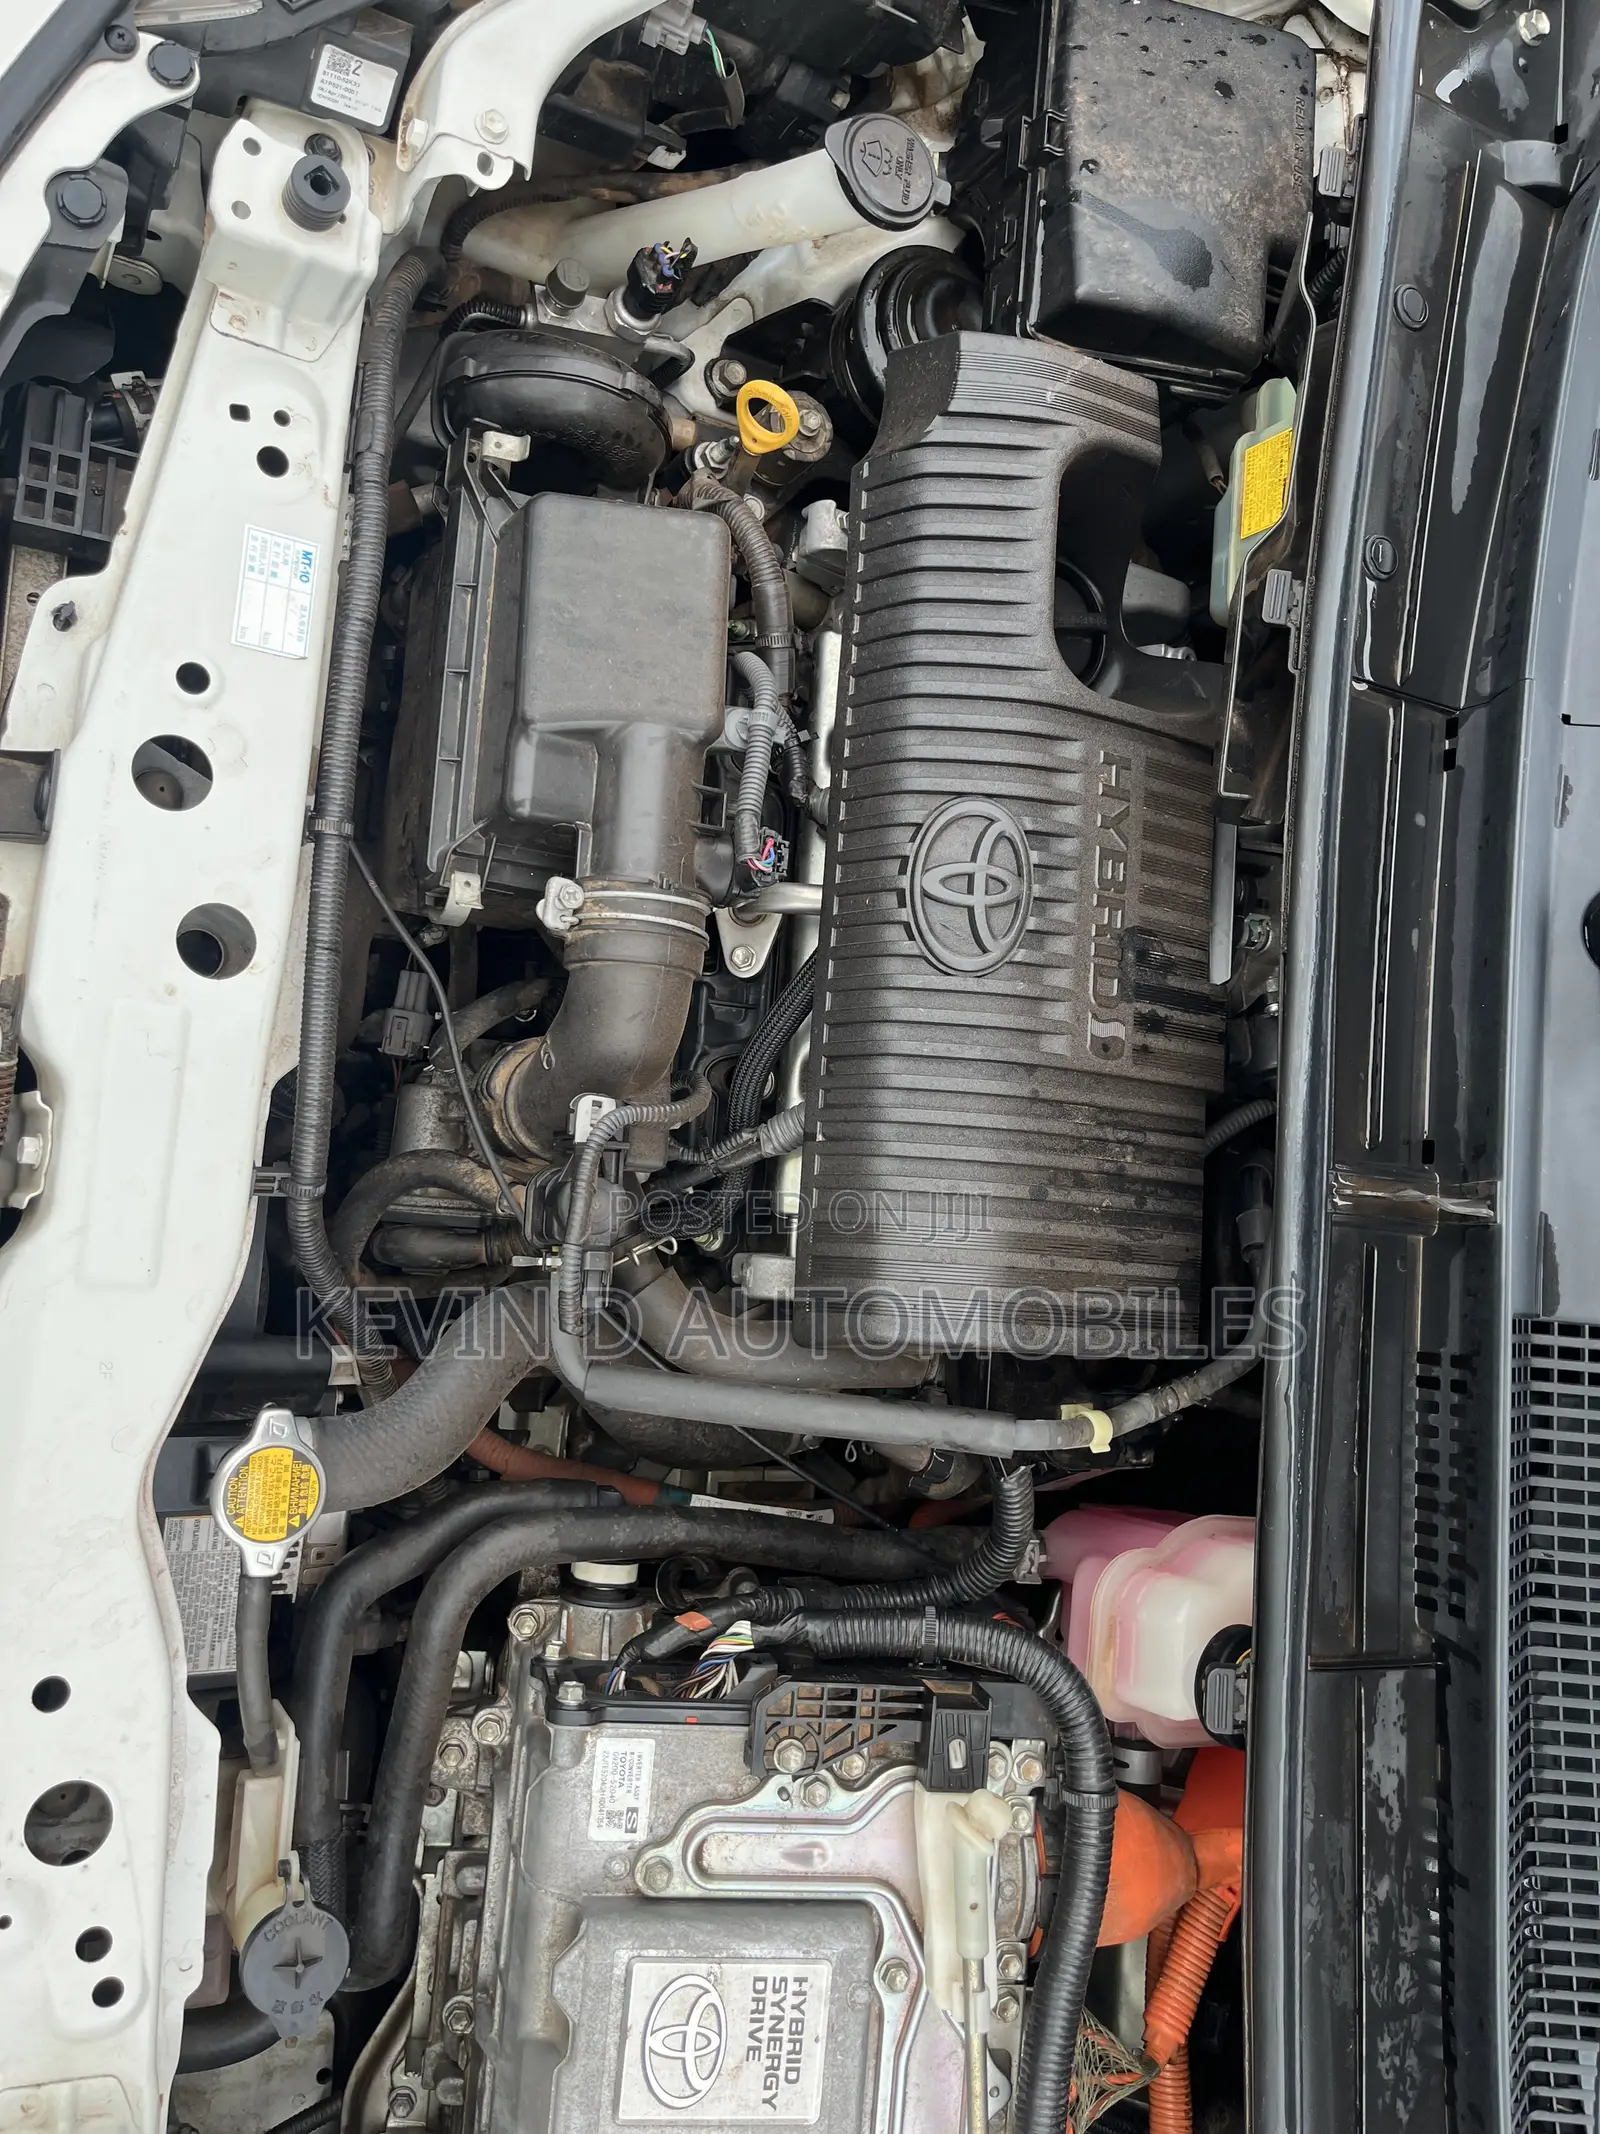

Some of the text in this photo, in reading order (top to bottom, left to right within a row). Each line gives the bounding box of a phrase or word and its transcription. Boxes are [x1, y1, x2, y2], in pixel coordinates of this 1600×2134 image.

[352, 60, 363, 76] 2
[1295, 96, 1305, 141] RELAY
[905, 138, 915, 176] WASHER
[1295, 143, 1303, 153] &
[895, 156, 904, 181] ONLY
[299, 550, 313, 583] MT-10
[1089, 749, 1132, 1008] HYBRID
[227, 1478, 238, 1515] CAUTION
[237, 1466, 248, 1514] ATTENTION
[290, 1460, 302, 1514] ВНИМАНИЕ!
[190, 1519, 201, 1551] VENTILATEURS
[618, 1751, 627, 1788] TOYOTA
[635, 1752, 643, 1781] INVERTER
[264, 1912, 334, 1942] COOLANT
[746, 1976, 768, 2063] DRIVE
[784, 1976, 809, 2085] HYBRID
[761, 1976, 788, 2111] SYNERGY
